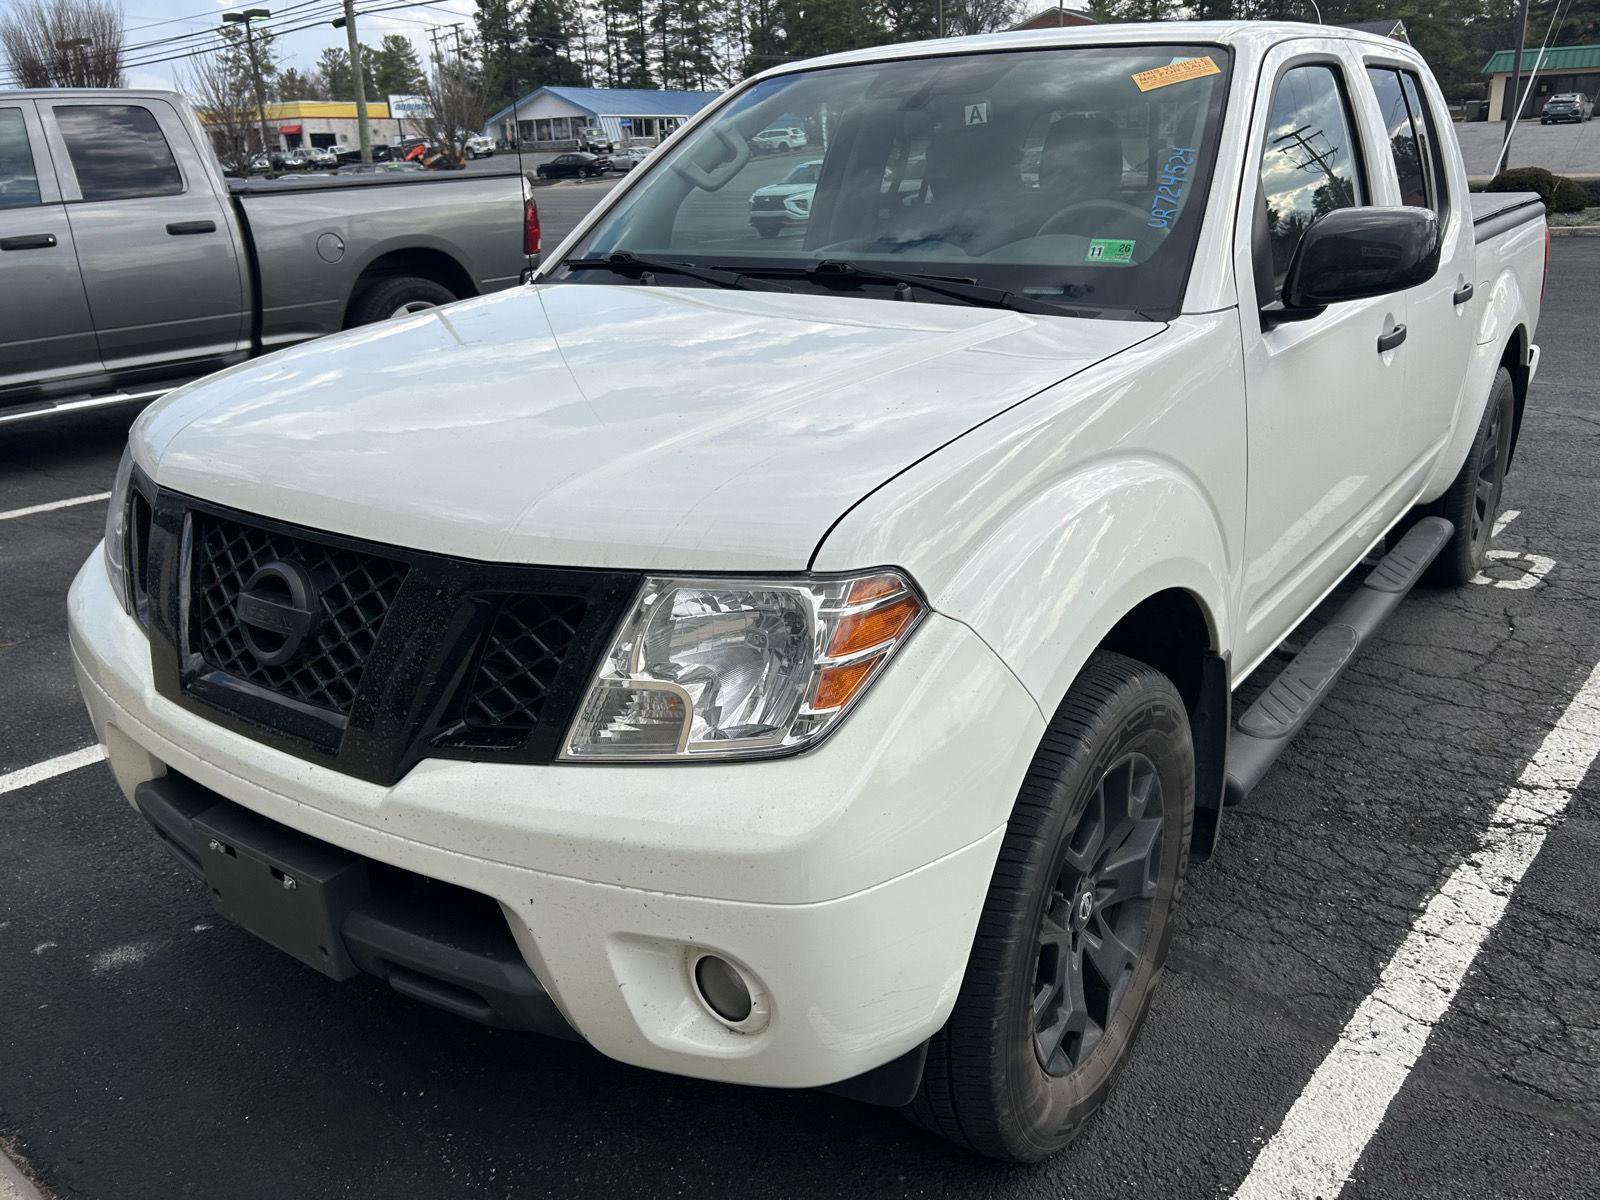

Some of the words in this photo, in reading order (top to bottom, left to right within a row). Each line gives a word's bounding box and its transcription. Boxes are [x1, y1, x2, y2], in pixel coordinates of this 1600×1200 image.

[1183, 60, 1209, 71] SALE
[970, 105, 983, 123] A
[1091, 246, 1103, 257] 11
[1118, 243, 1132, 253] 26
